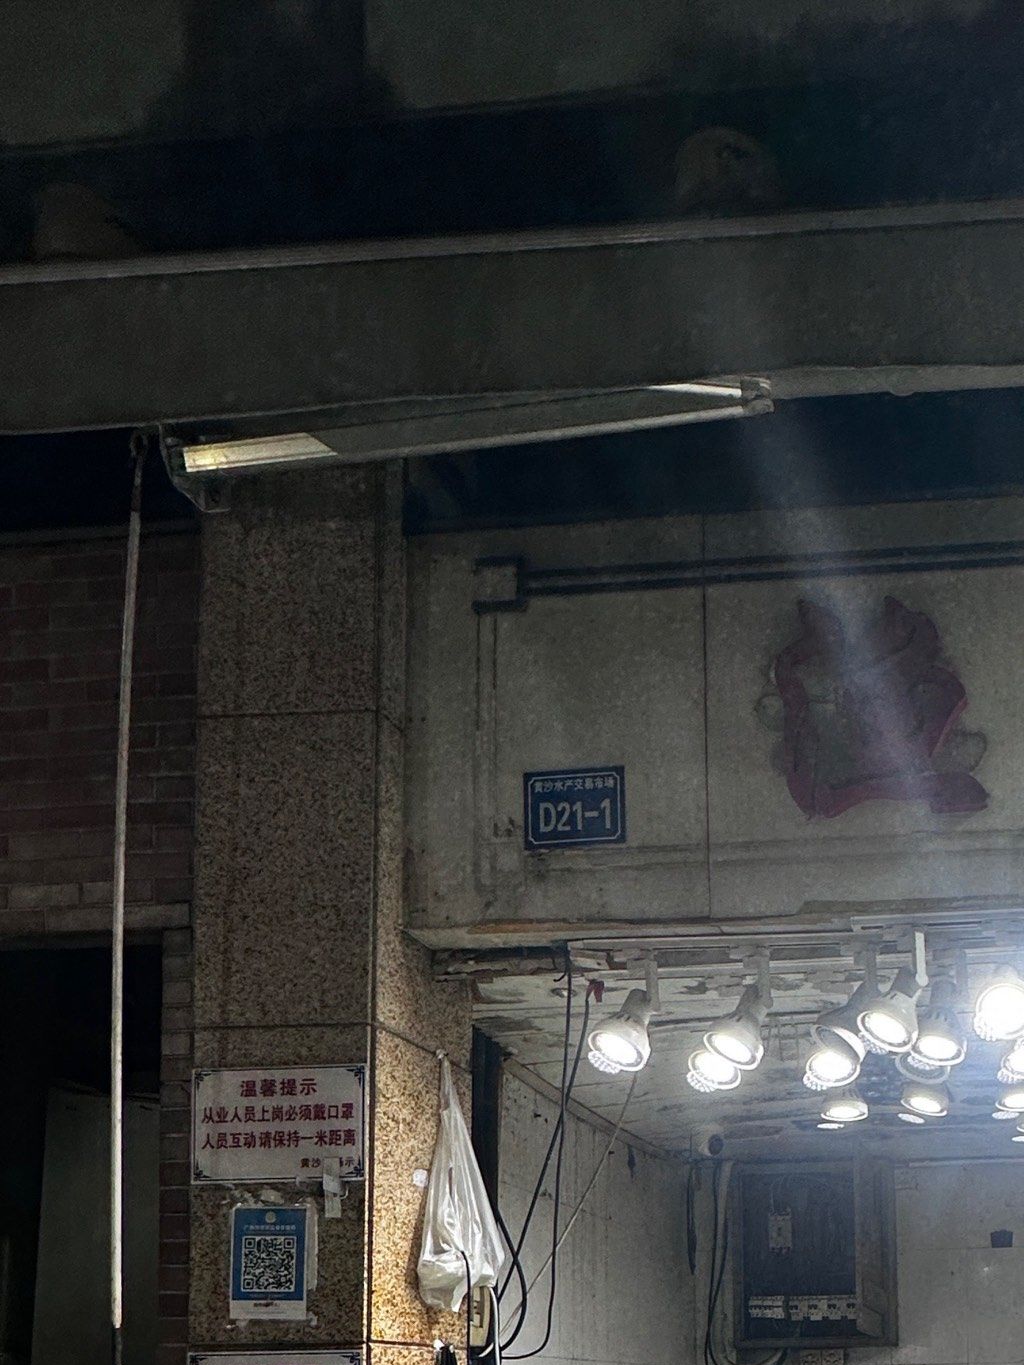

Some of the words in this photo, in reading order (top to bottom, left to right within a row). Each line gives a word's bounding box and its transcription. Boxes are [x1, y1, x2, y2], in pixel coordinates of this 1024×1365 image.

[534, 776, 615, 793] 黄沙水产交易市场
[539, 797, 611, 832] D21-1
[240, 1077, 318, 1098] 温馨提示
[201, 1102, 355, 1124] 从业人员上岗必须戴口罩
[201, 1128, 356, 1150] 人员互动请保持一米距离
[300, 1156, 355, 1169] 黄沙示
